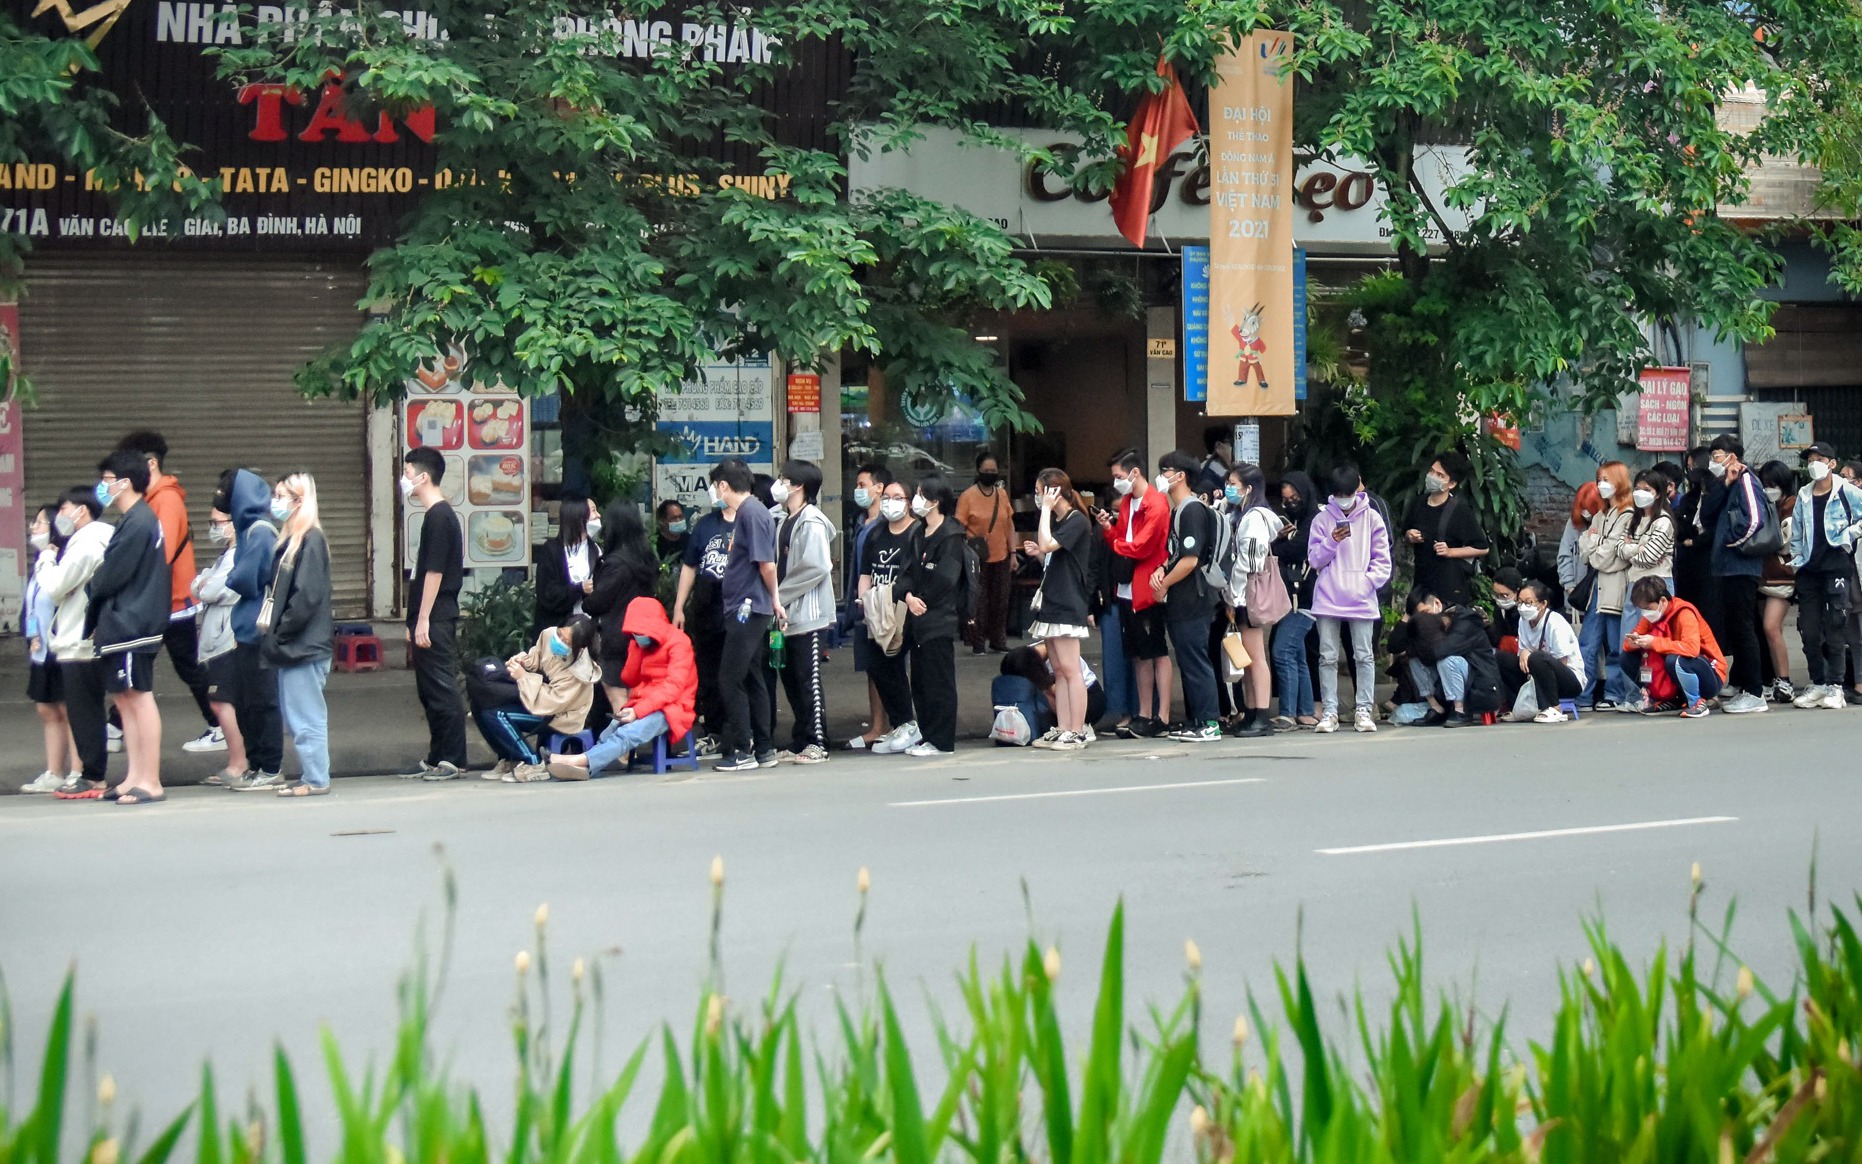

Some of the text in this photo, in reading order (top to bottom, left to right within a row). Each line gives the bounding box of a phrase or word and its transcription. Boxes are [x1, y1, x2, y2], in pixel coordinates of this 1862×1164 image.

[156, 0, 243, 45] NHÀ
[1223, 104, 1271, 126] ĐẠI HỘI
[1246, 131, 1269, 142] THAO
[1248, 152, 1267, 163] NAM
[219, 167, 290, 193] TATA
[313, 166, 413, 193] GINGKO
[718, 173, 793, 200] SHINY
[1216, 165, 1239, 185] LẦN
[1216, 187, 1281, 213] VIỆT NAM
[1299, 171, 1375, 223] ẹo
[59, 214, 95, 236] VĂN
[227, 217, 251, 235] BA
[257, 213, 302, 236] ĐÌNH,
[305, 213, 328, 235] HÀ
[334, 213, 361, 239] NỘI
[1229, 218, 1270, 239] 2021
[1670, 381, 1687, 398] GẠO
